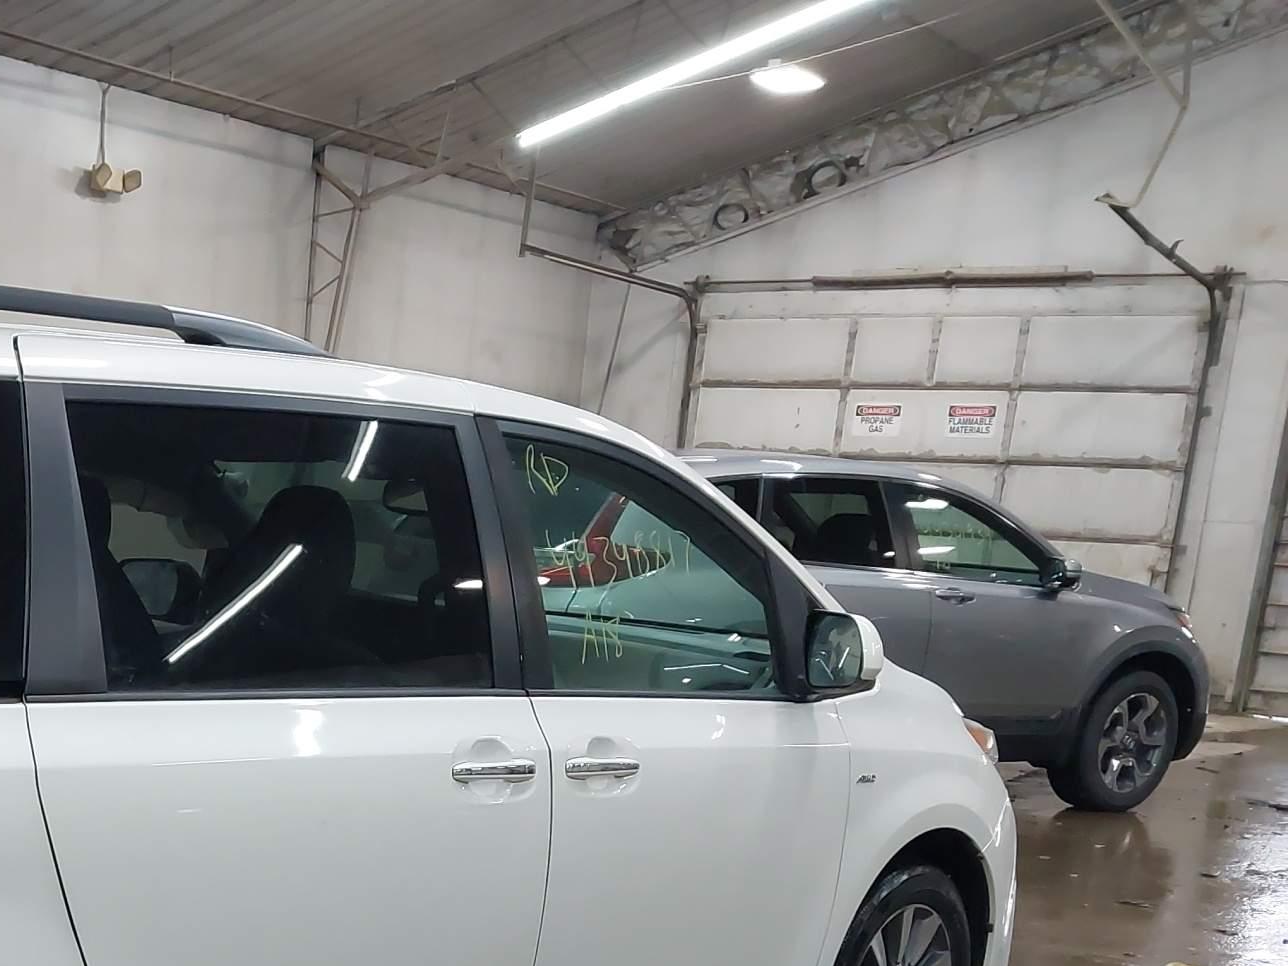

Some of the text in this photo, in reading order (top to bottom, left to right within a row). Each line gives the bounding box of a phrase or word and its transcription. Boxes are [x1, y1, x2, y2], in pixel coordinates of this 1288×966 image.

[862, 407, 895, 415] DANGER
[955, 407, 989, 415] DANGER
[860, 416, 894, 424] PROPANE
[948, 417, 993, 426] FLAMMABLE
[950, 426, 990, 434] MATERIALS
